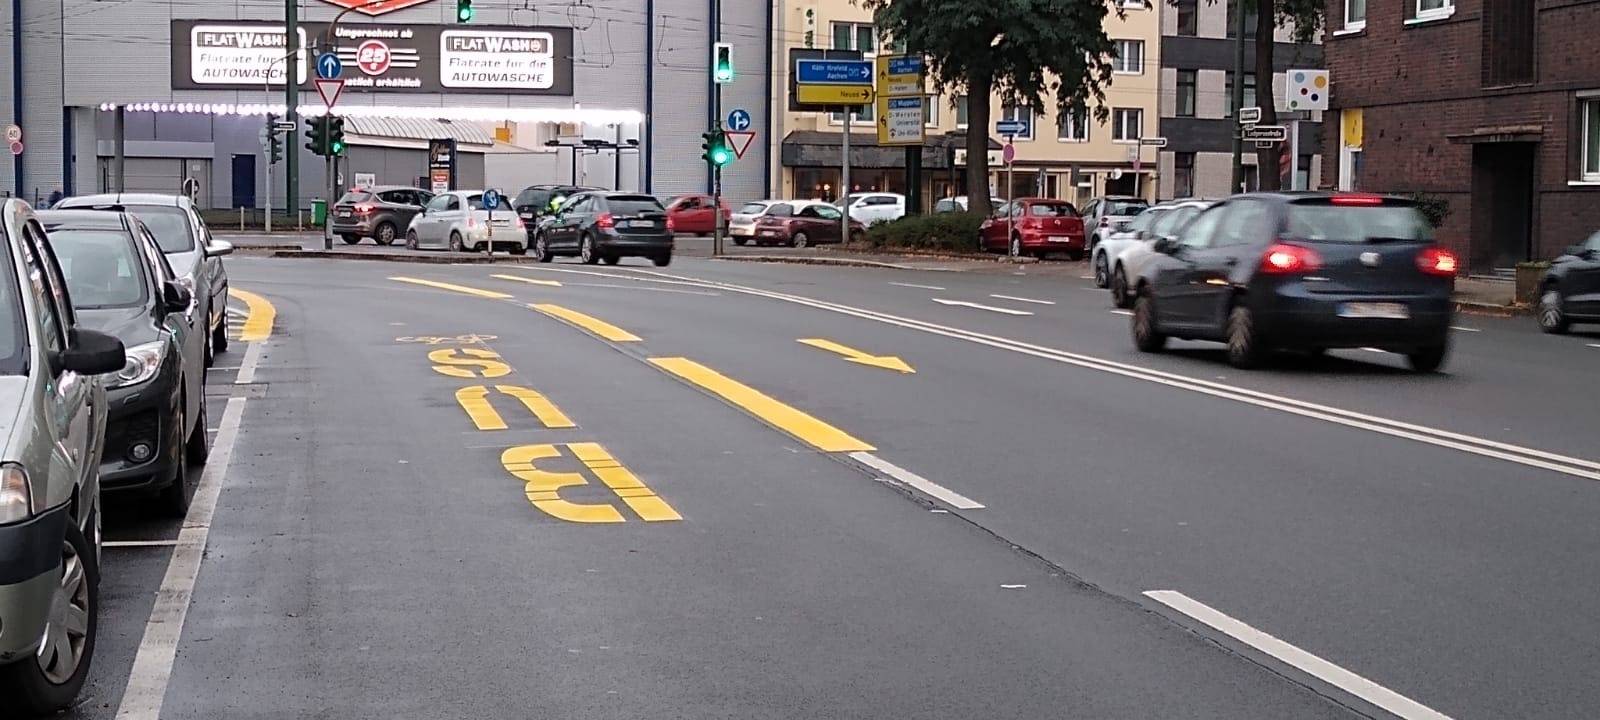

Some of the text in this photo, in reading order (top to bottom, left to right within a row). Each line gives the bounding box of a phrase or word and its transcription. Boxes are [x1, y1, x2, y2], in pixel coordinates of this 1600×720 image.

[335, 27, 414, 39] Umgerechnet ab
[200, 53, 252, 64] Flatrate
[360, 47, 387, 63] 25
[449, 57, 501, 68] Flatrate
[529, 58, 547, 69] die
[376, 77, 421, 88] erhältlich
[428, 348, 683, 523] BUS
